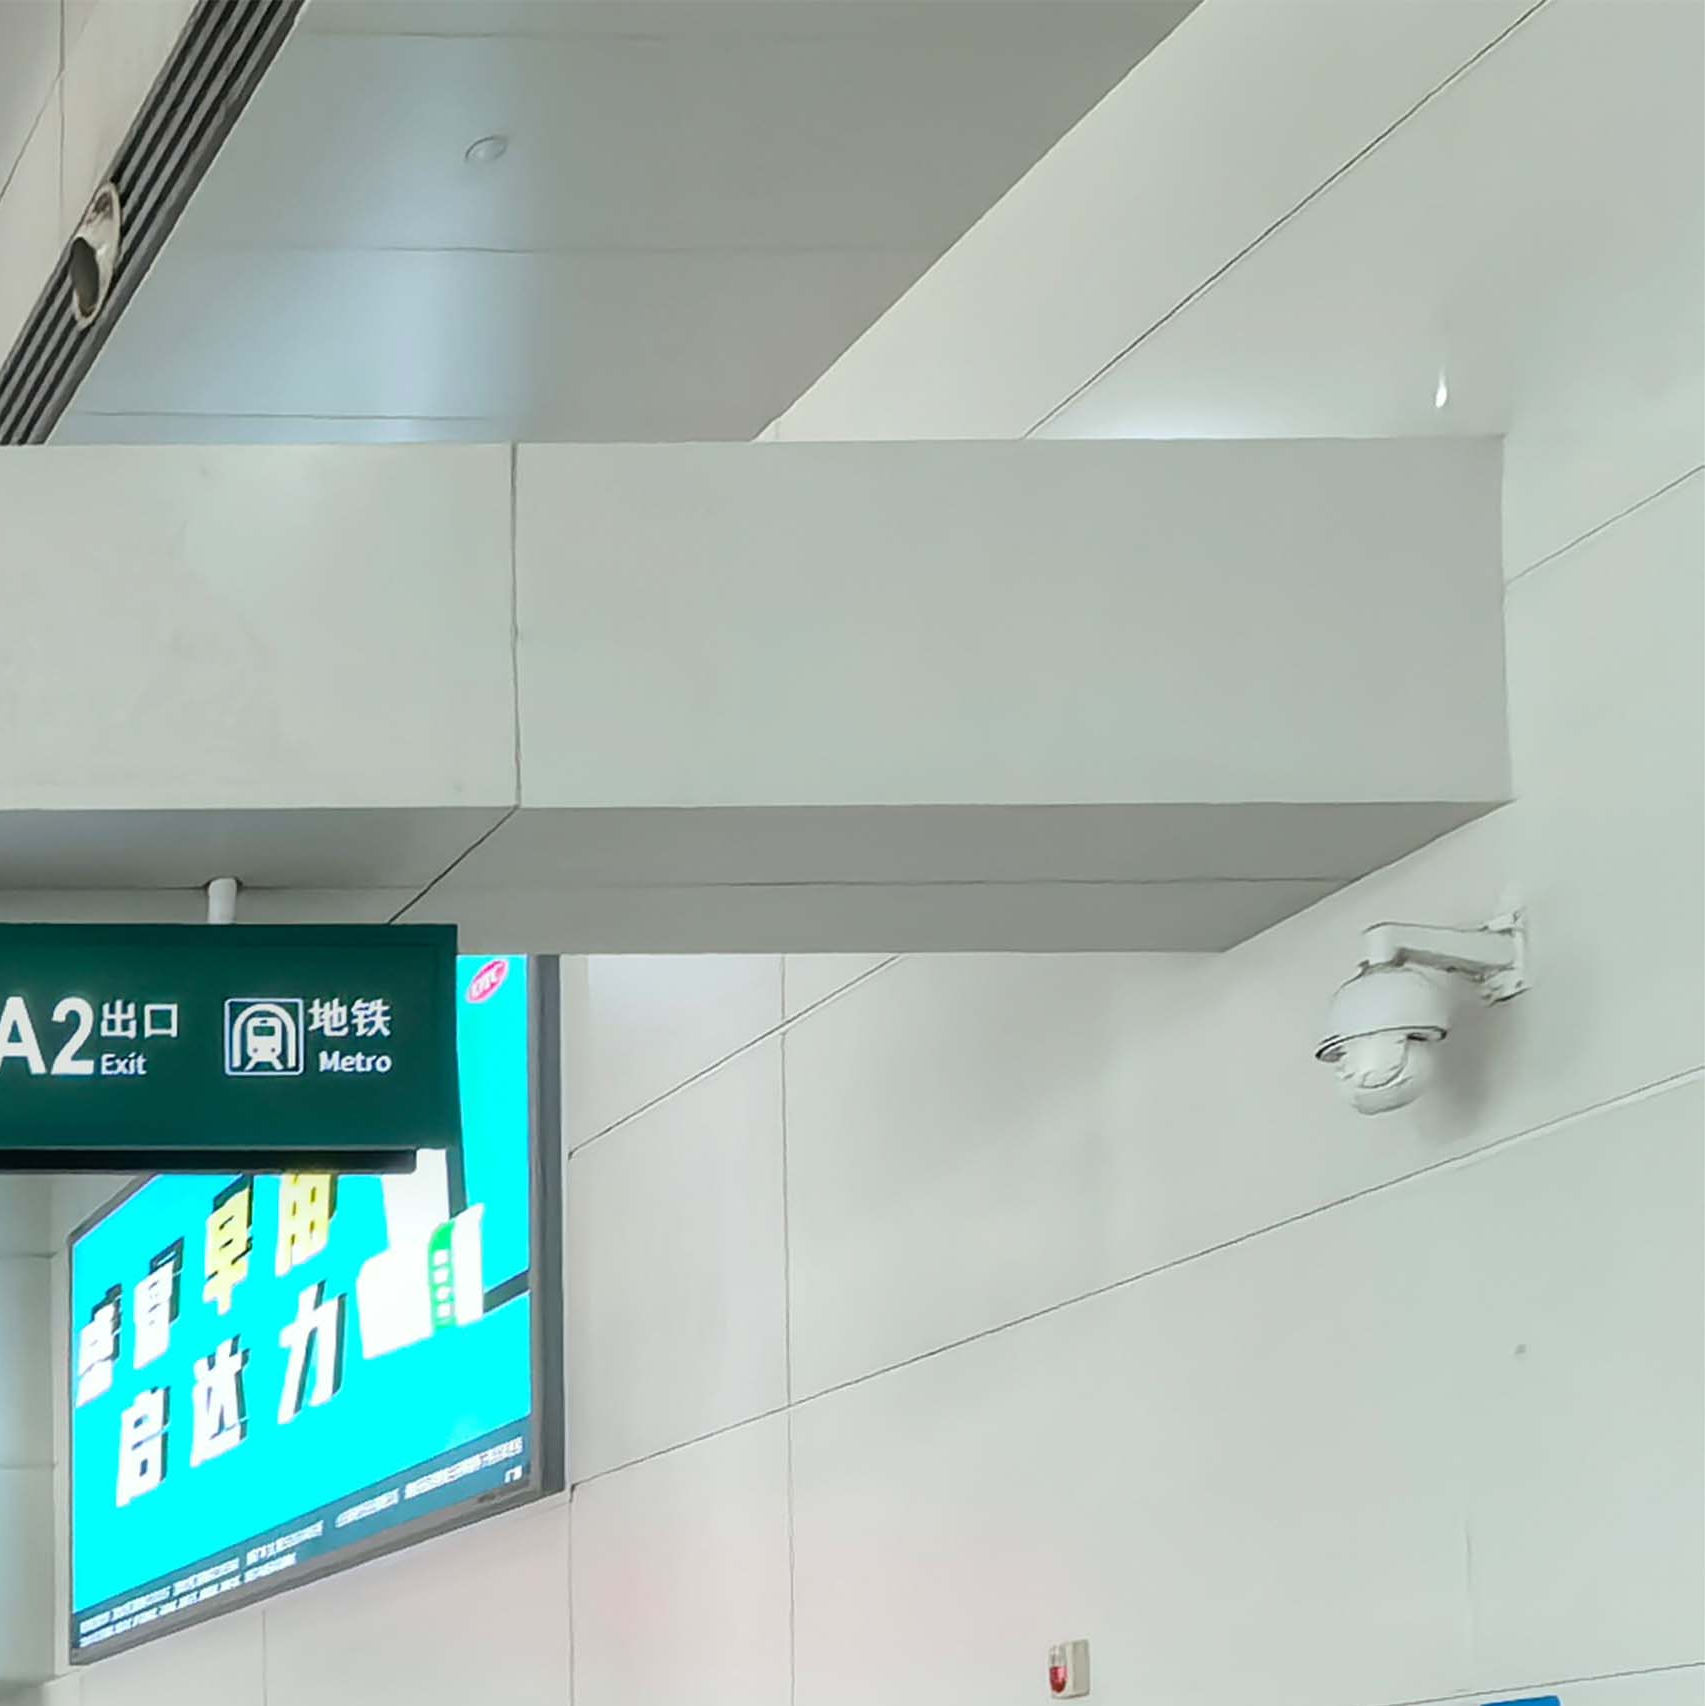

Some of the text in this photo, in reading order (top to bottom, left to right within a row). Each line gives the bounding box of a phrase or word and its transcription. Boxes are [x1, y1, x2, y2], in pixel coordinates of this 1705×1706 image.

[100, 1000, 179, 1038] 出口
[307, 998, 392, 1038] 地铁
[100, 1051, 148, 1075] Exit
[319, 1050, 392, 1073] Metro
